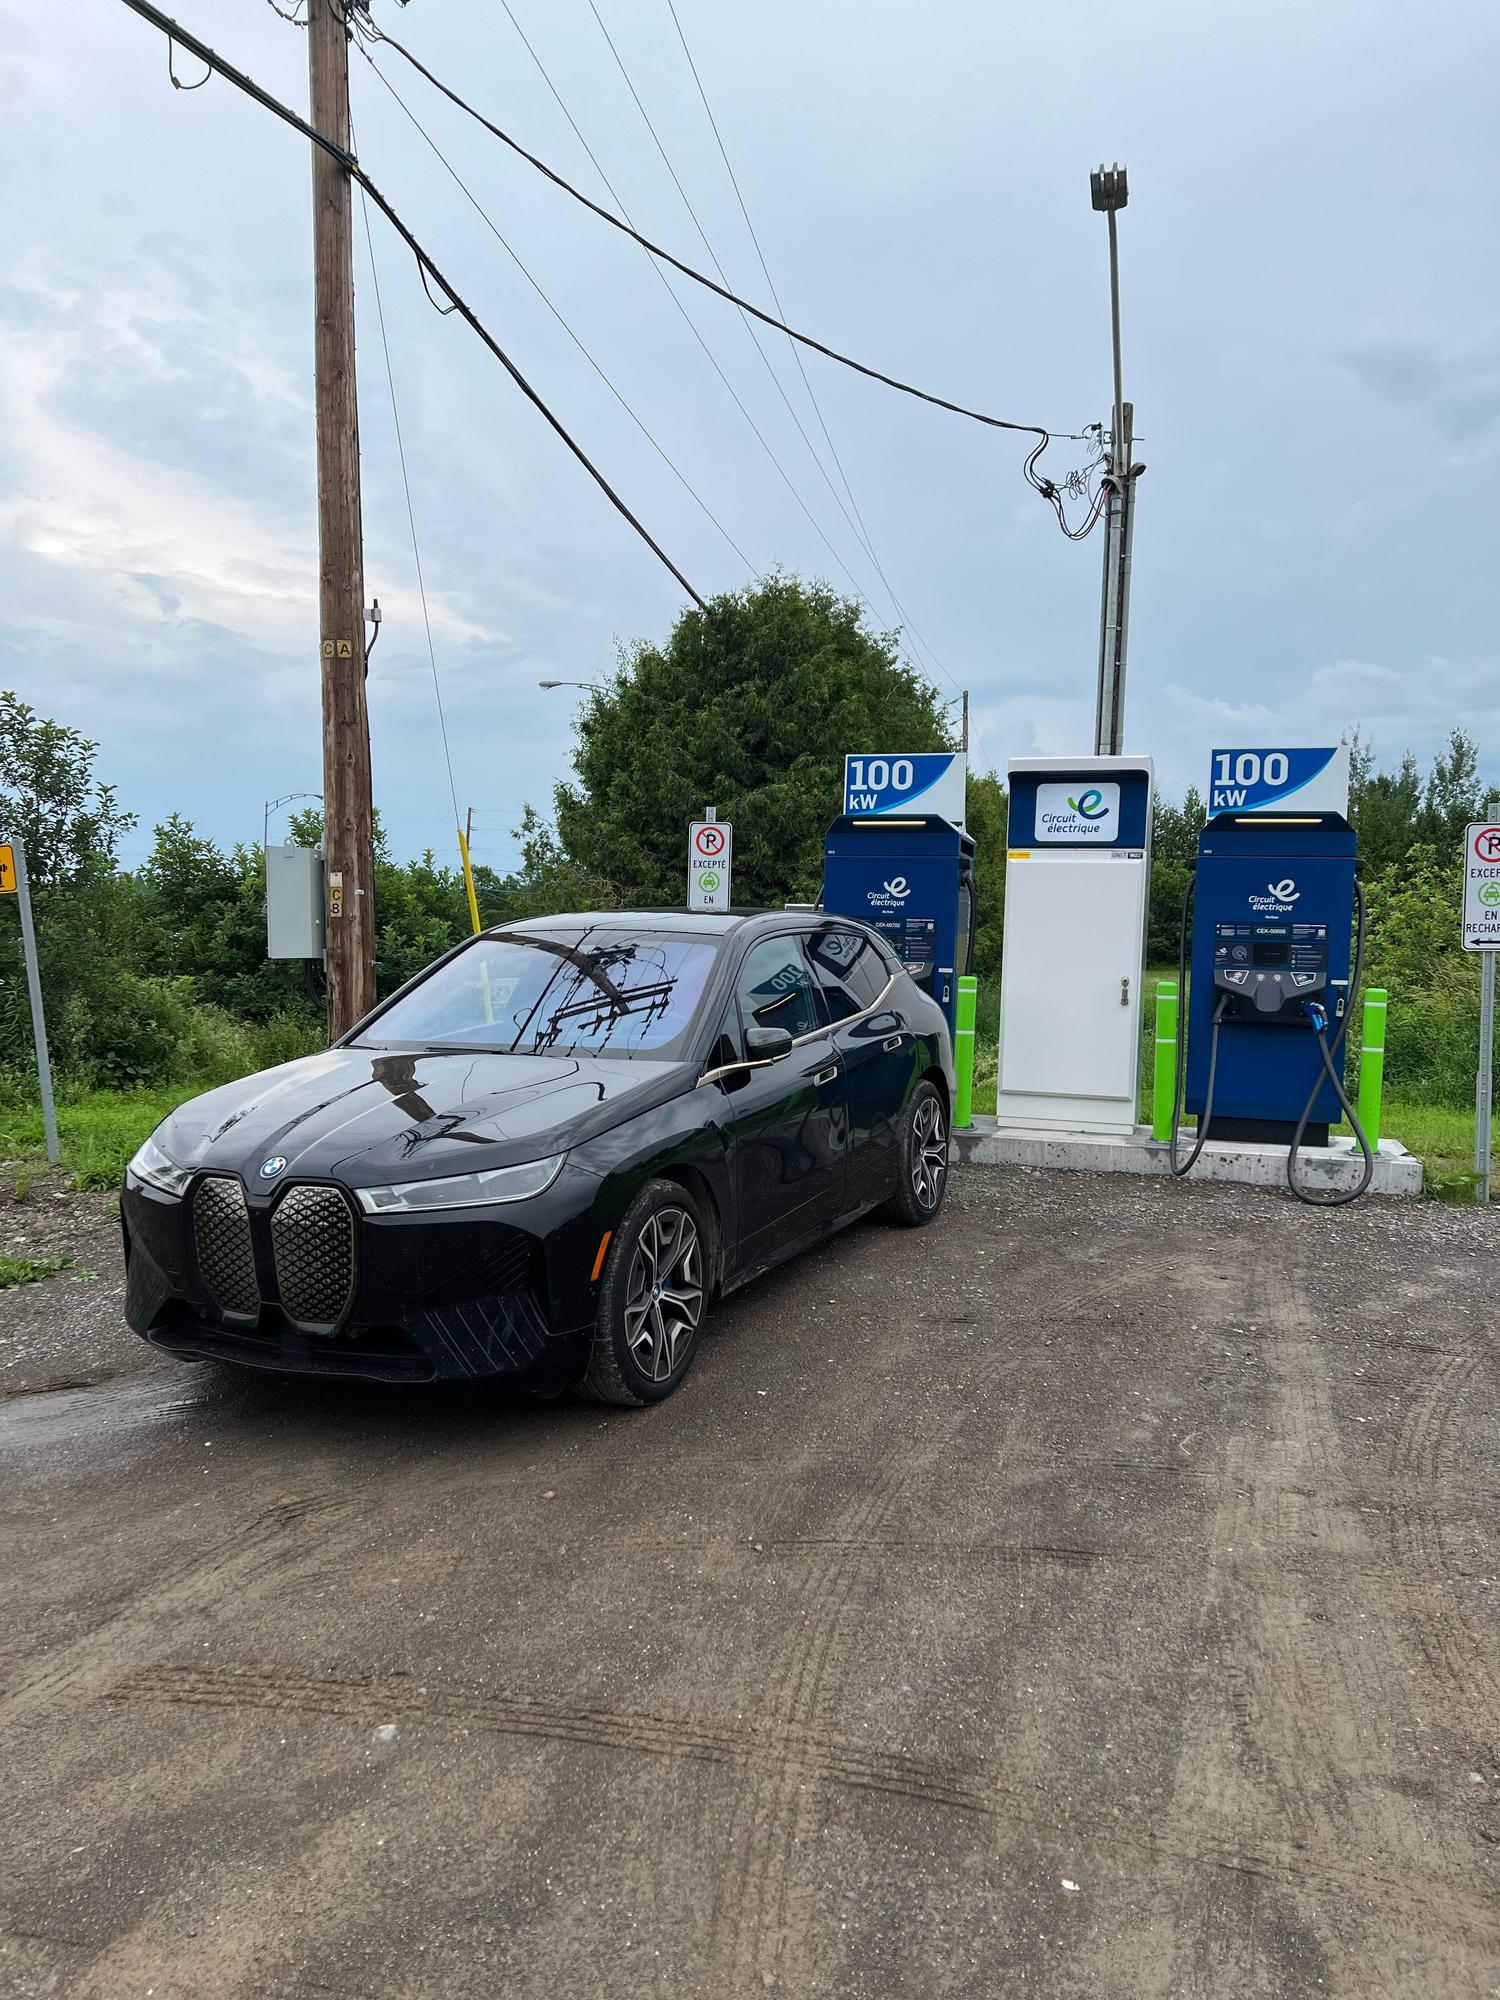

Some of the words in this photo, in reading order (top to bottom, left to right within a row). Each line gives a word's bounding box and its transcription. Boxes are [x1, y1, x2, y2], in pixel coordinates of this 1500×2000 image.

[324, 643, 333, 655] C
[340, 643, 350, 655] A
[1214, 752, 1289, 786] 100
[850, 759, 914, 791] 100
[849, 793, 878, 810] kW
[1213, 789, 1247, 807] kW
[1041, 813, 1077, 823] Circuit
[1047, 823, 1101, 835] électrique
[332, 889, 341, 900] C
[703, 895, 714, 904] EN
[867, 891, 890, 899] Circuit
[1248, 895, 1276, 904] Circuit
[332, 903, 340, 914] B
[870, 899, 905, 907] électrique
[1252, 902, 1294, 912] électrique
[1484, 910, 1498, 921] EN
